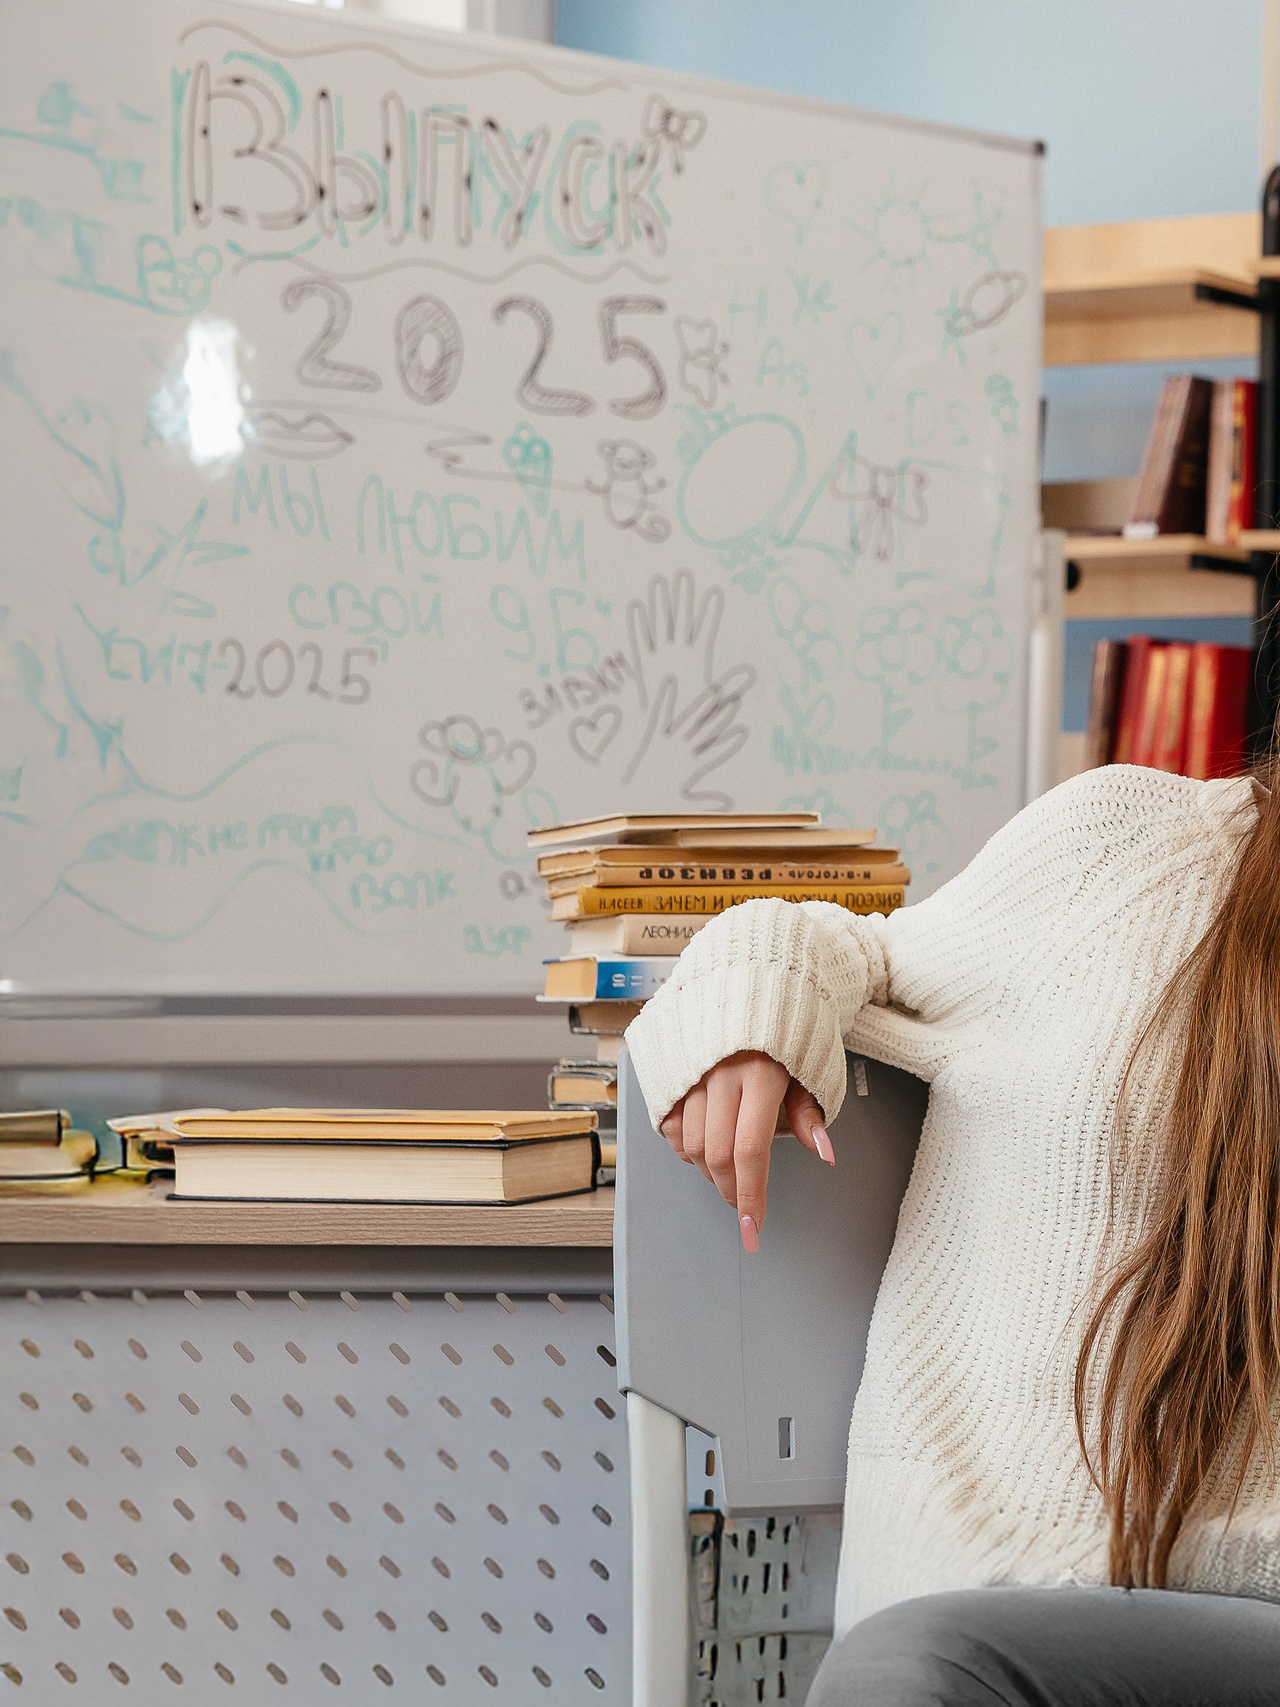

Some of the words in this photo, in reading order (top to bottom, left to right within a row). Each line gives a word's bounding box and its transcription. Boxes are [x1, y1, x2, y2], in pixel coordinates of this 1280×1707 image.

[283, 278, 668, 421] 2025
[639, 867, 772, 880] РЕВИЗОР
[654, 894, 706, 911] ЗАЧЕМ
[713, 895, 724, 910] И
[845, 891, 902, 909] ПОЭЗИЯ
